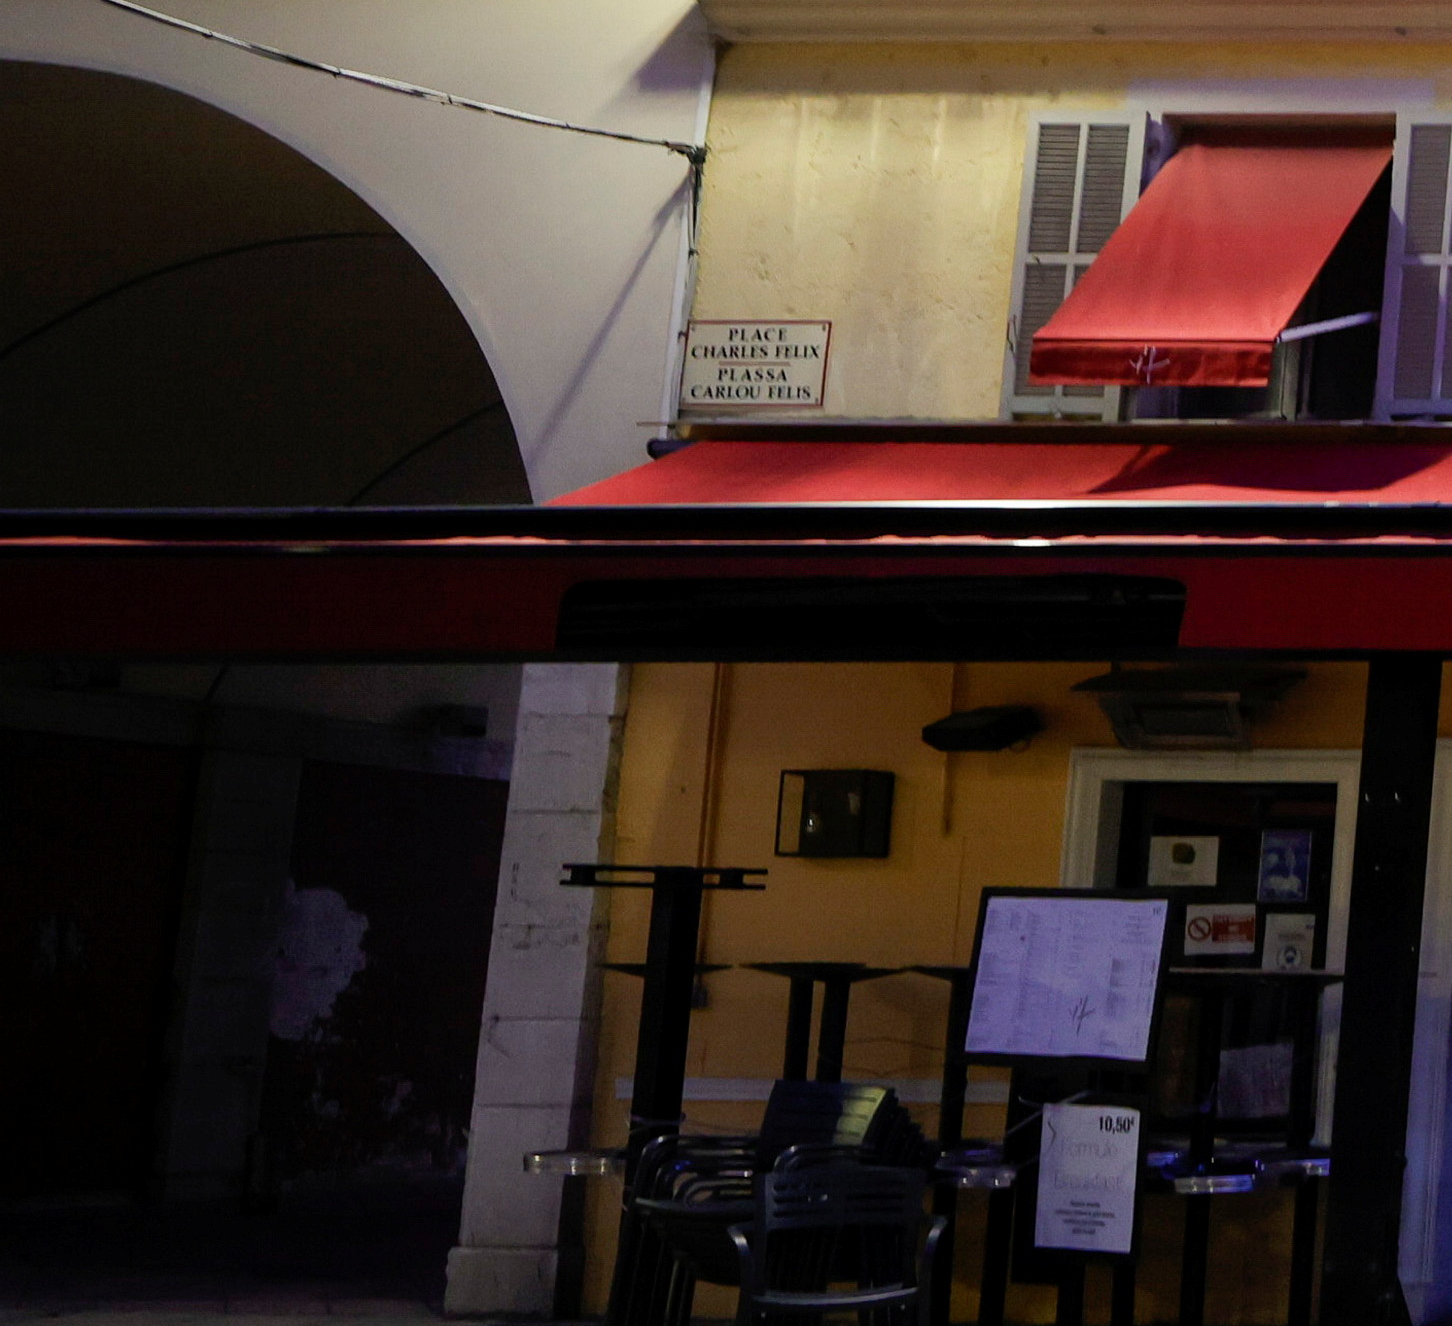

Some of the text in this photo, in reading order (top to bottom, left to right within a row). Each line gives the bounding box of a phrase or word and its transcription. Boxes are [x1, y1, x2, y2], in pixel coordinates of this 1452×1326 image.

[728, 328, 788, 342] PLACE
[691, 345, 820, 359] CHARLES FELIX
[717, 368, 788, 383] PLASSA
[690, 385, 812, 400] CARLOU FELIS
